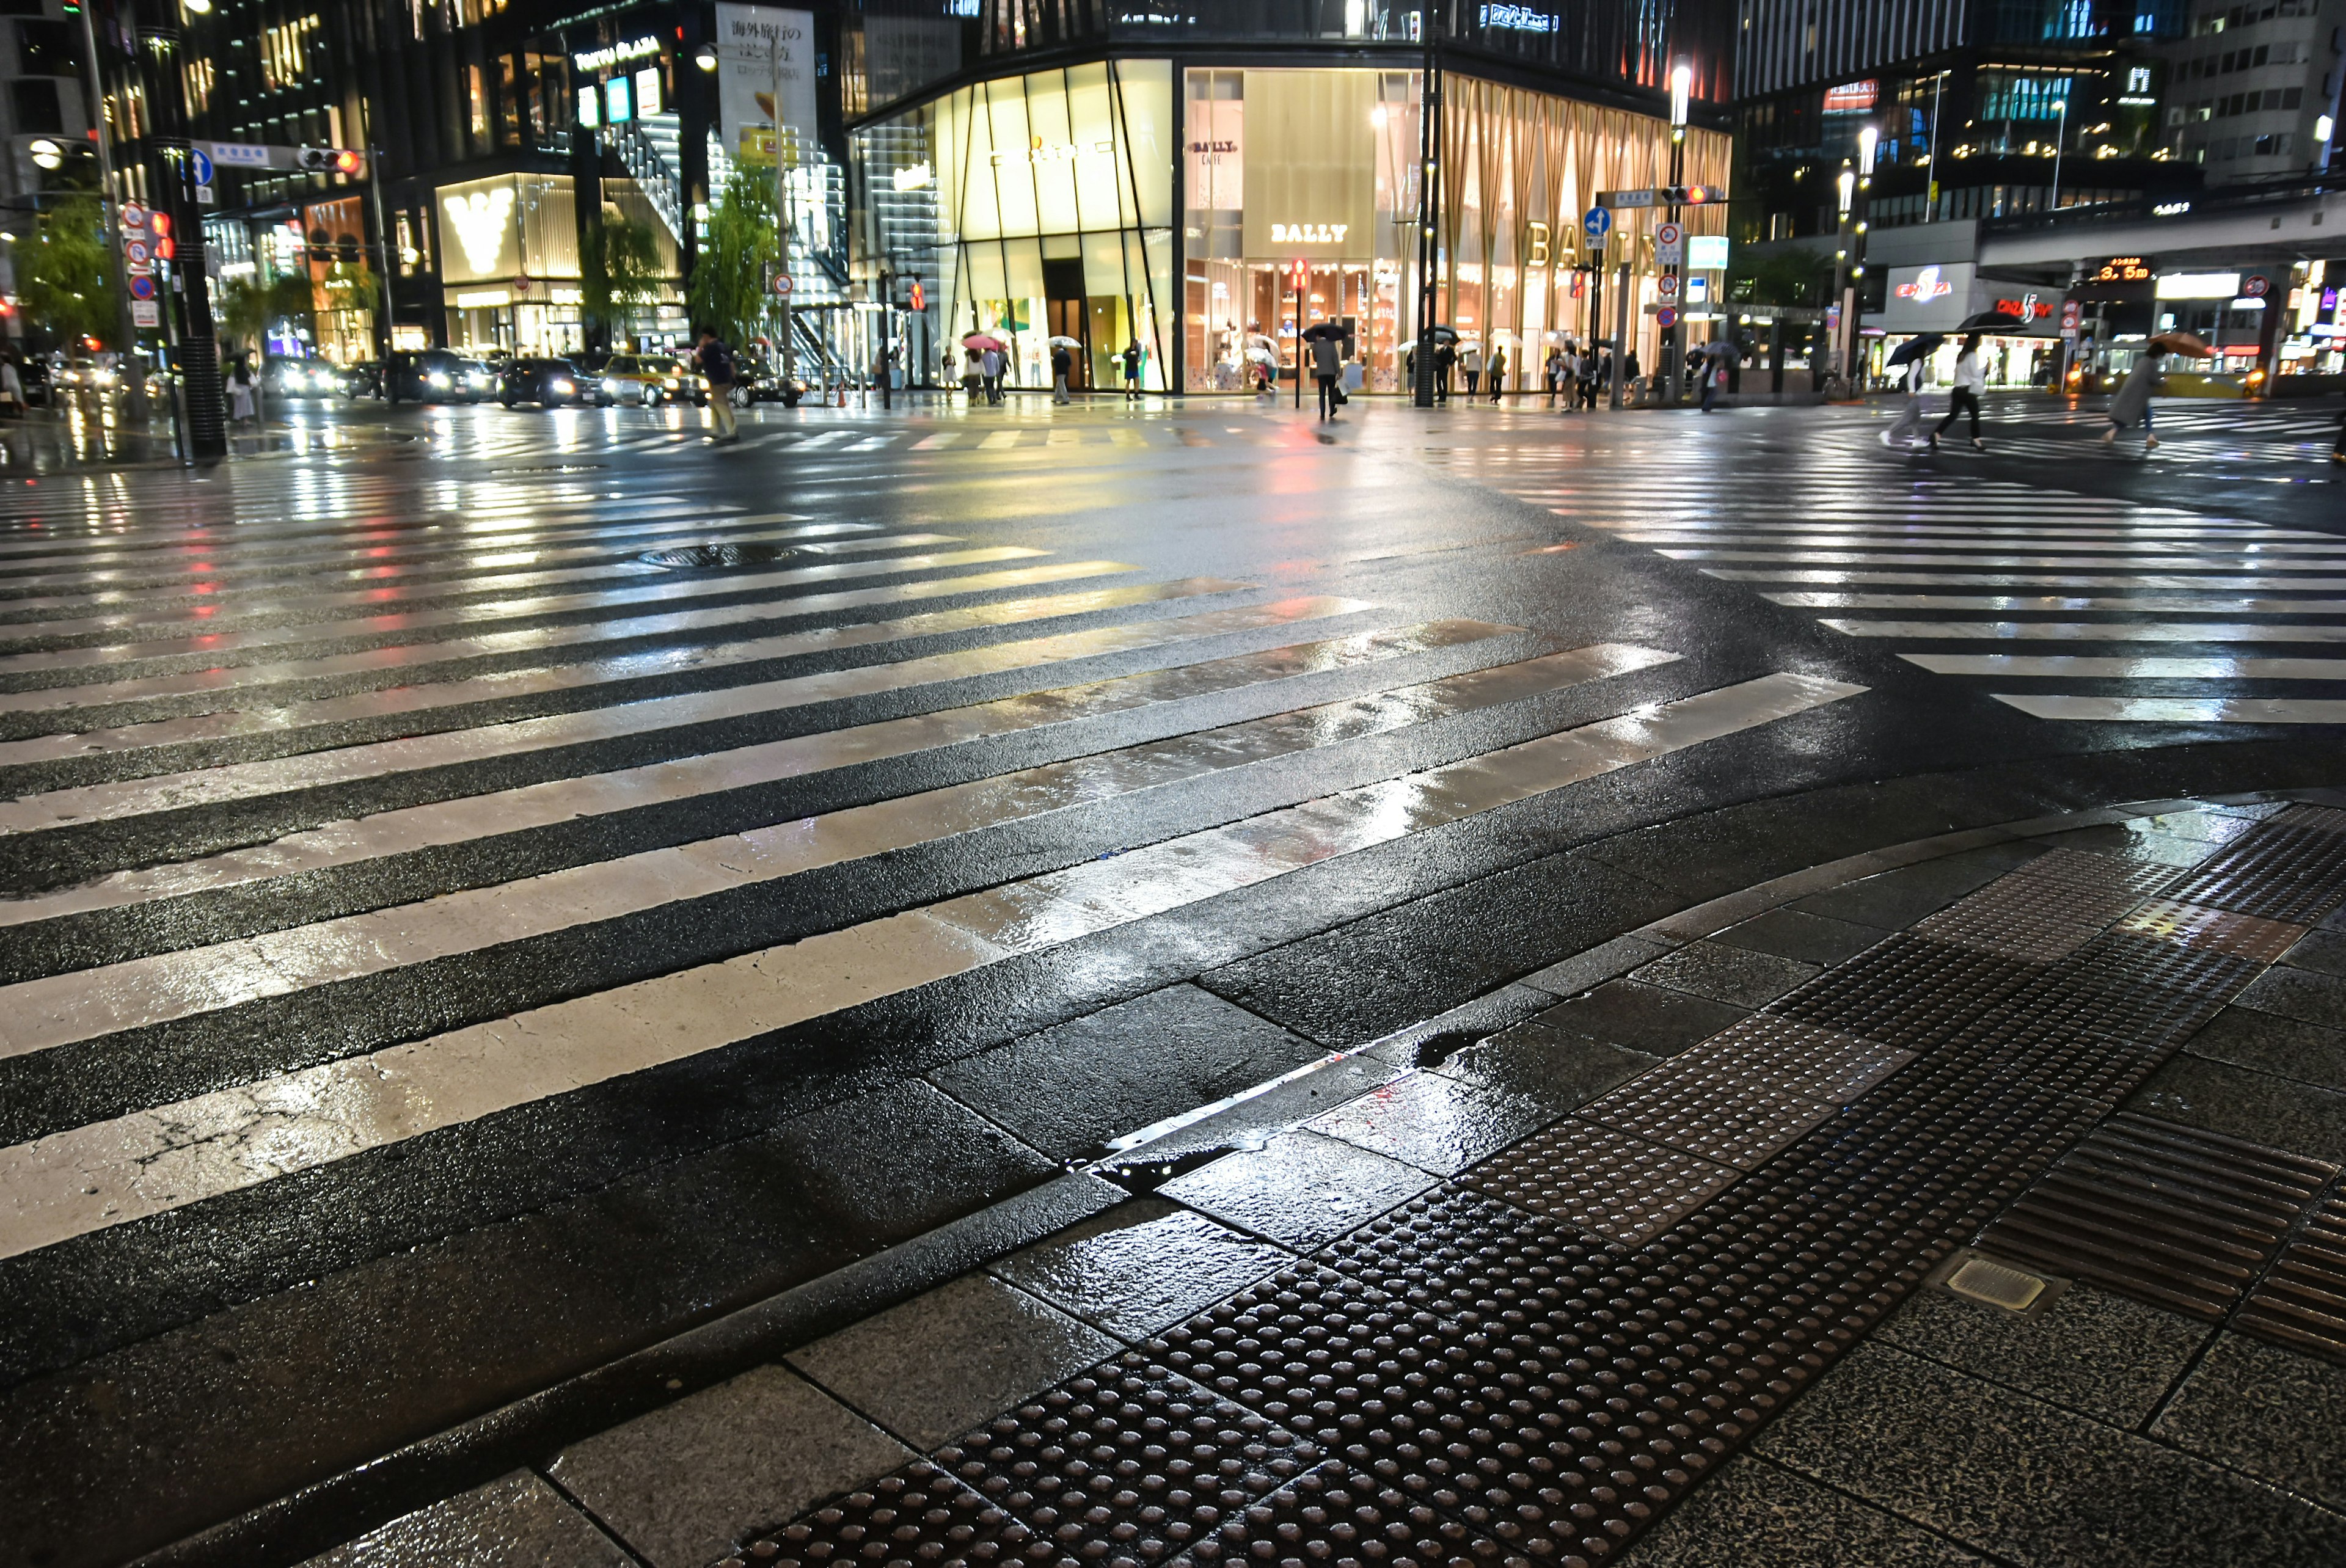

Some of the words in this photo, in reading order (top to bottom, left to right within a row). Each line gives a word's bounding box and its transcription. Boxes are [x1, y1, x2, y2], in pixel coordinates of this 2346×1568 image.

[732, 20, 801, 41] 海外旅行の
[574, 47, 616, 72] TOKYU
[616, 35, 660, 62] PLAZA
[1193, 141, 1233, 153] BALLY
[1271, 224, 1348, 242] BALLY
[1528, 221, 1656, 277] BALY
